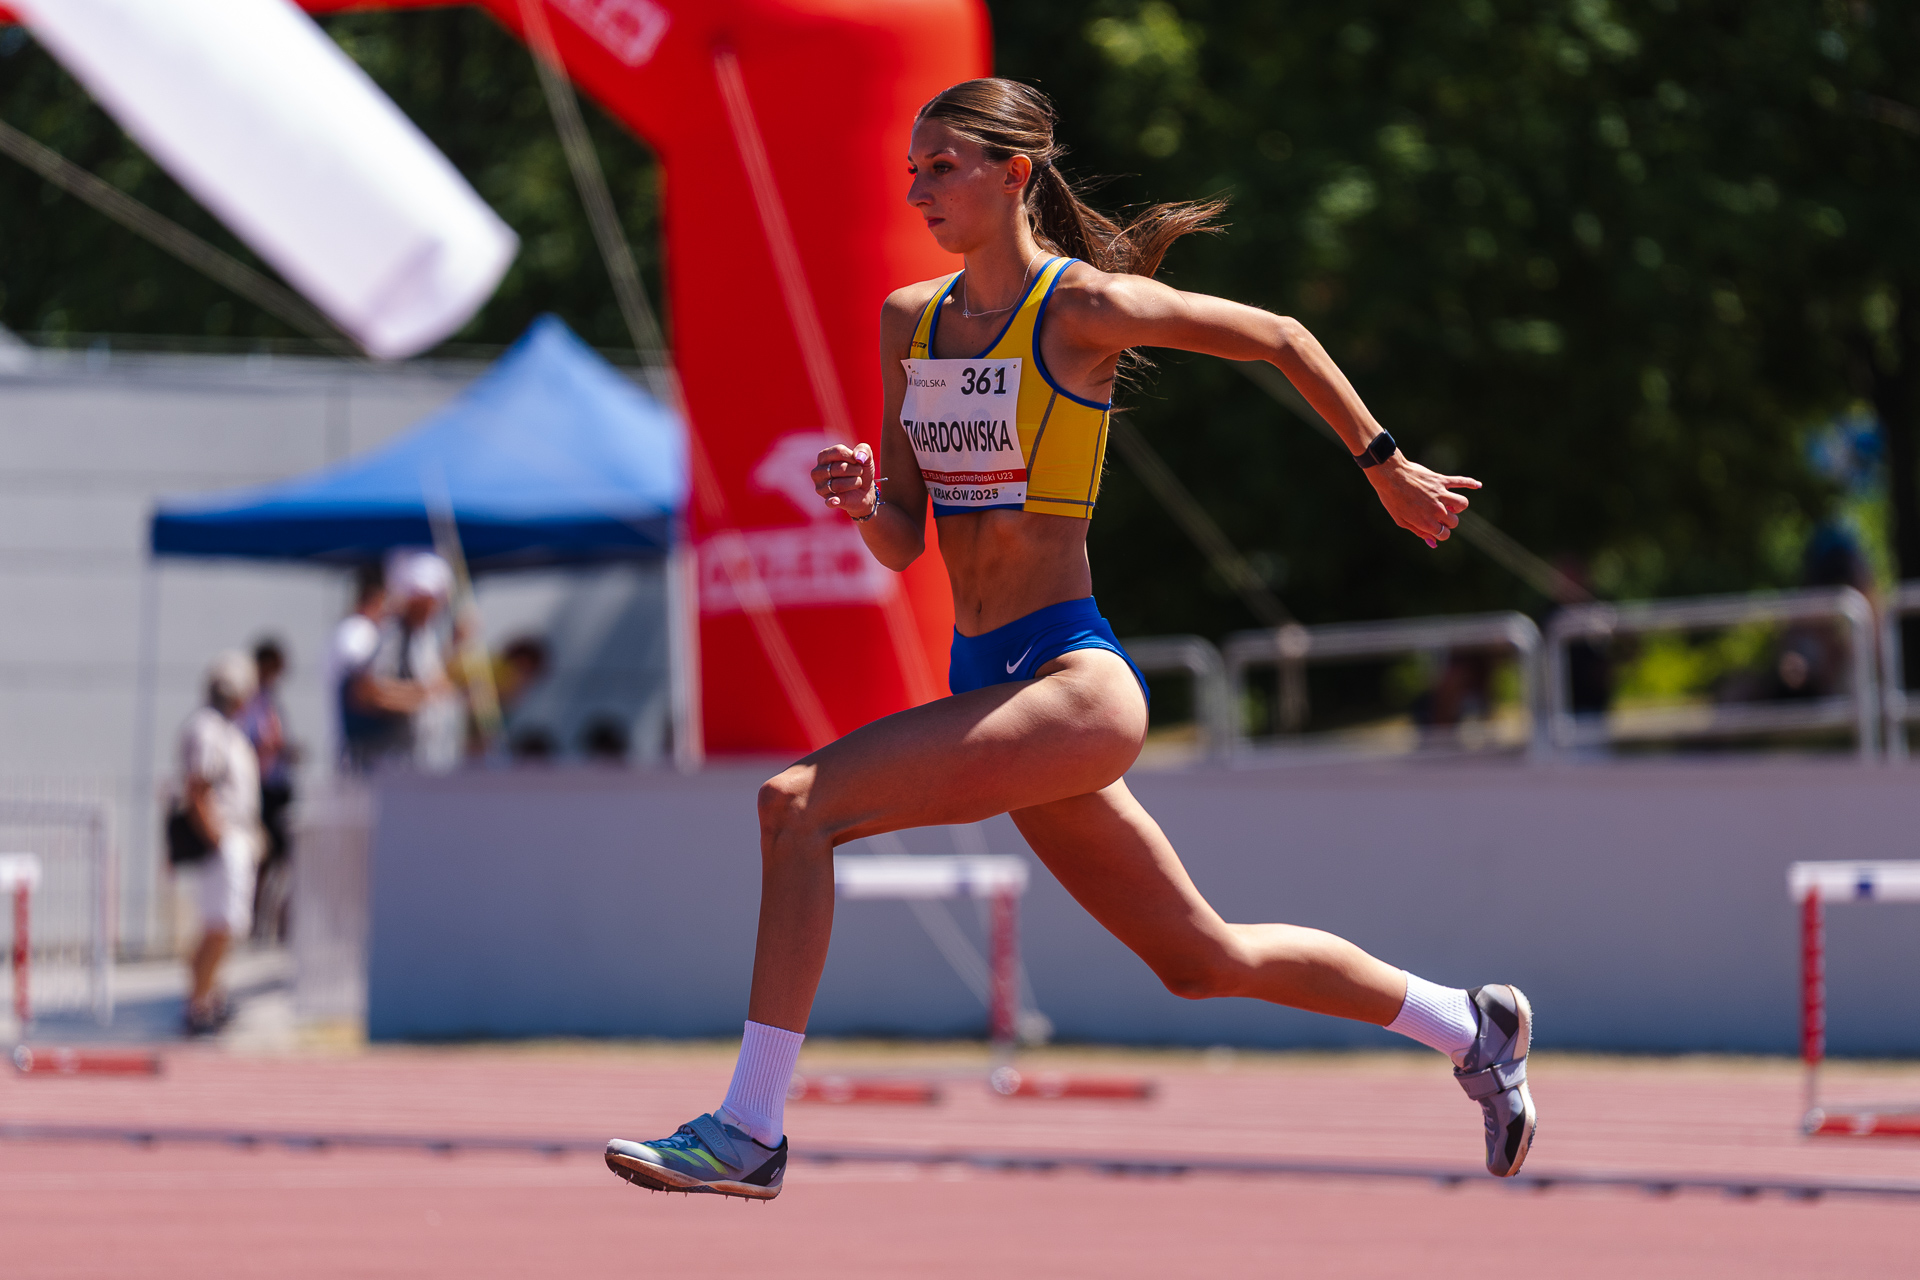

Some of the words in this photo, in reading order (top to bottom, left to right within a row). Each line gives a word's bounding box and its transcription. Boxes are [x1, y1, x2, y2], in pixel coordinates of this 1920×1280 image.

[960, 367, 1007, 395] 361
[903, 419, 1014, 452] TWARDOWSKA
[974, 473, 996, 482] Polski
[996, 471, 1014, 480] U23
[933, 487, 969, 501] KRAKÓW
[970, 488, 999, 501] 2025
